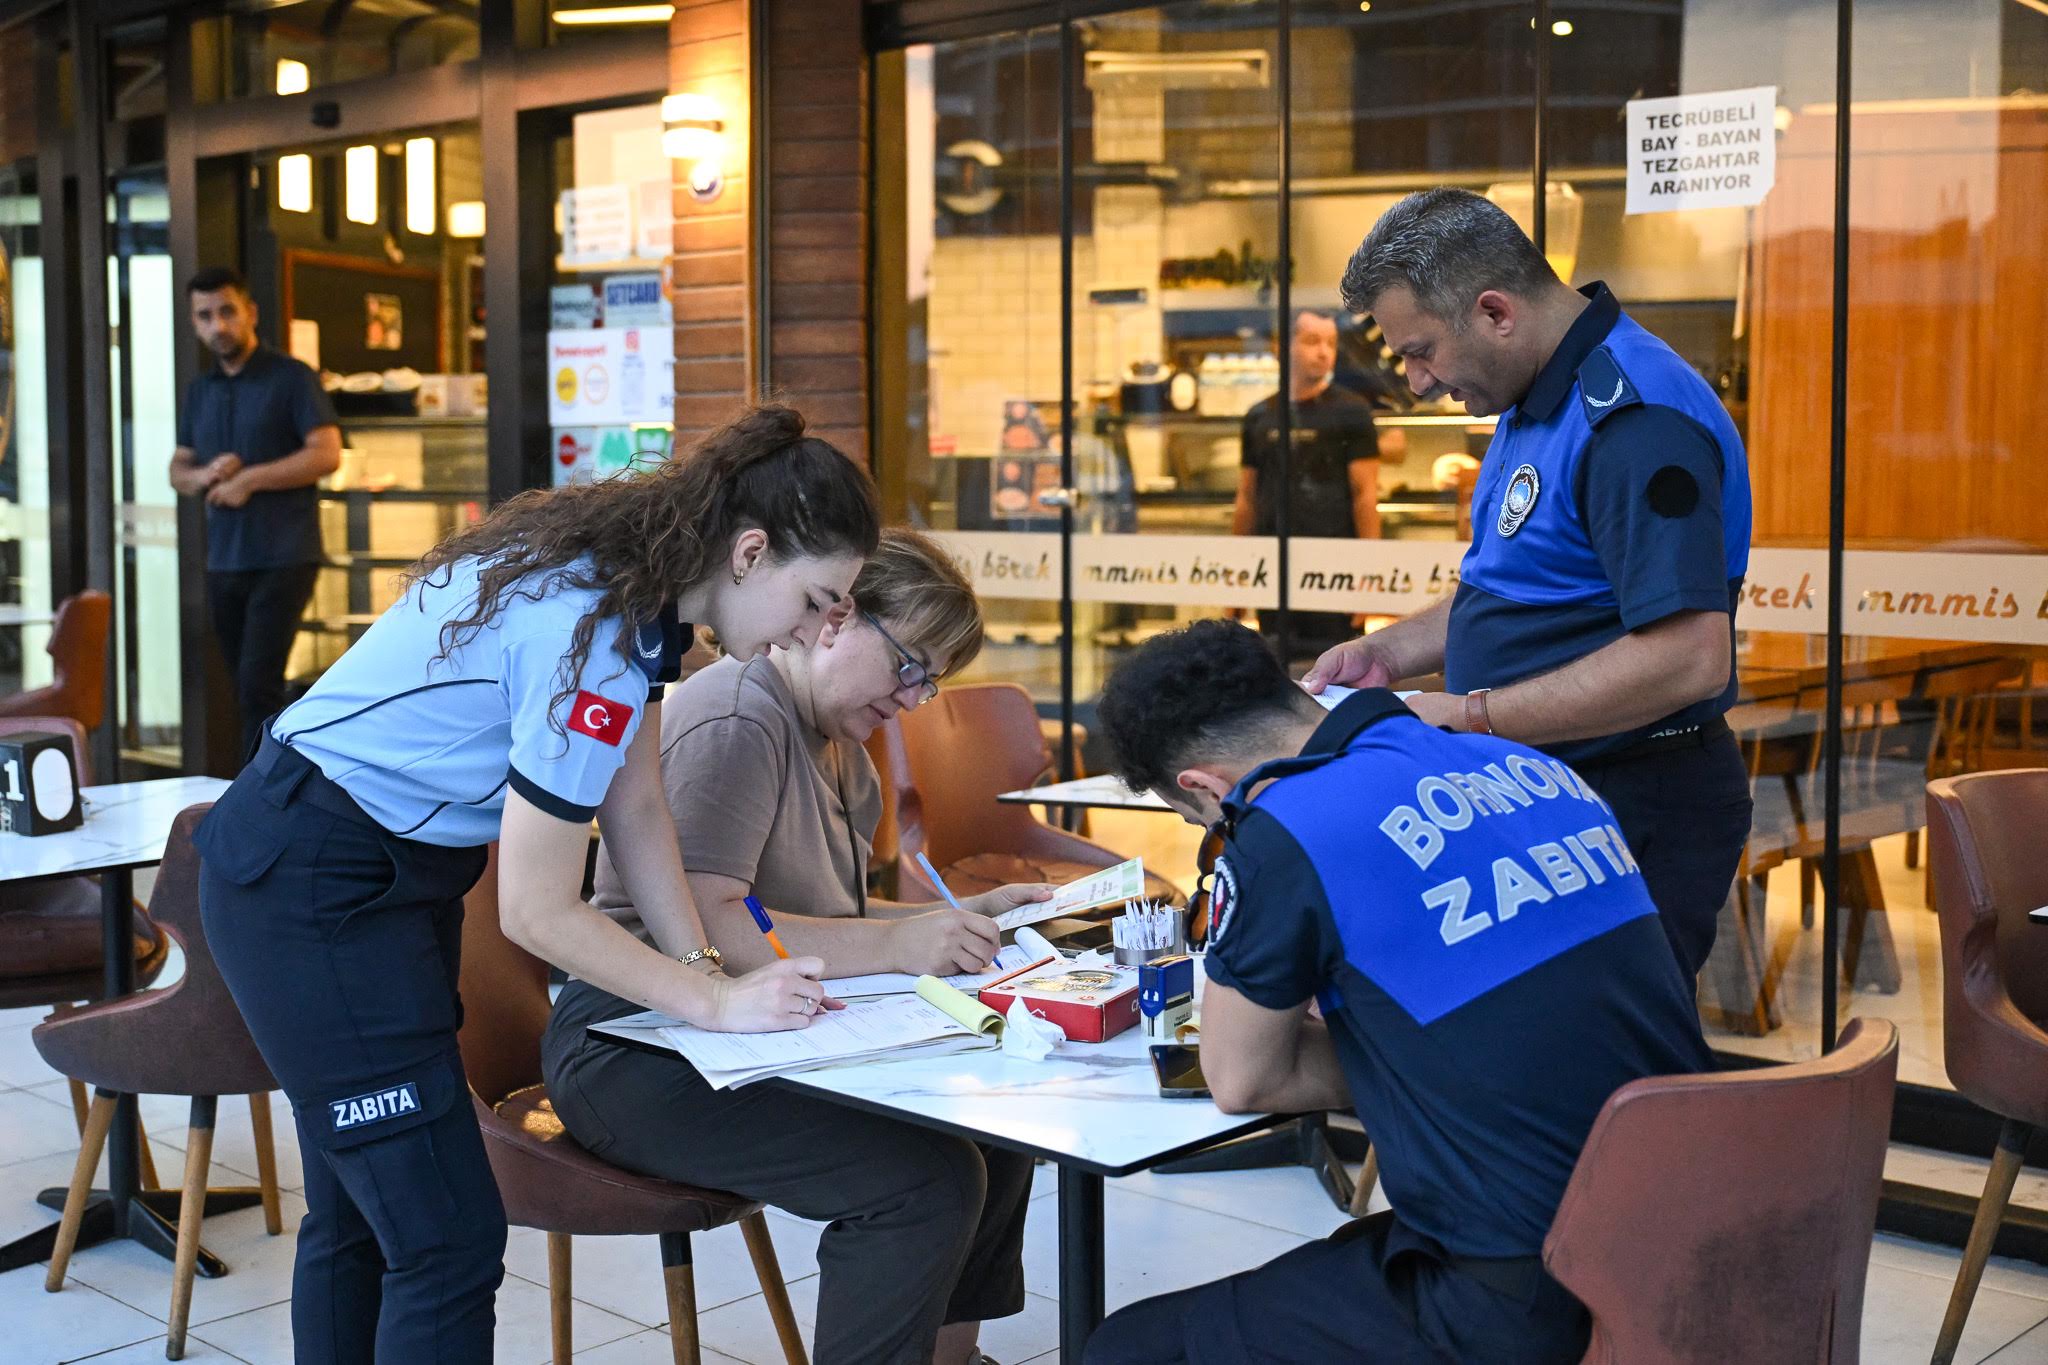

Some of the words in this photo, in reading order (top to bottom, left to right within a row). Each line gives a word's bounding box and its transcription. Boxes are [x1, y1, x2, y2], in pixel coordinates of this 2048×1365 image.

[1646, 102, 1756, 131] TECRÜBELİ
[1641, 136, 1678, 153] BAY
[1697, 128, 1761, 148] BAYAN
[1643, 151, 1760, 174] TEZGAHTAR
[1650, 174, 1752, 196] ARANIYOR
[1189, 556, 1268, 588] börek
[1299, 567, 1414, 594] mmmis
[1739, 571, 1813, 610] rek
[1420, 824, 1641, 947] ZABITA
[333, 1087, 416, 1128] ZABITA
